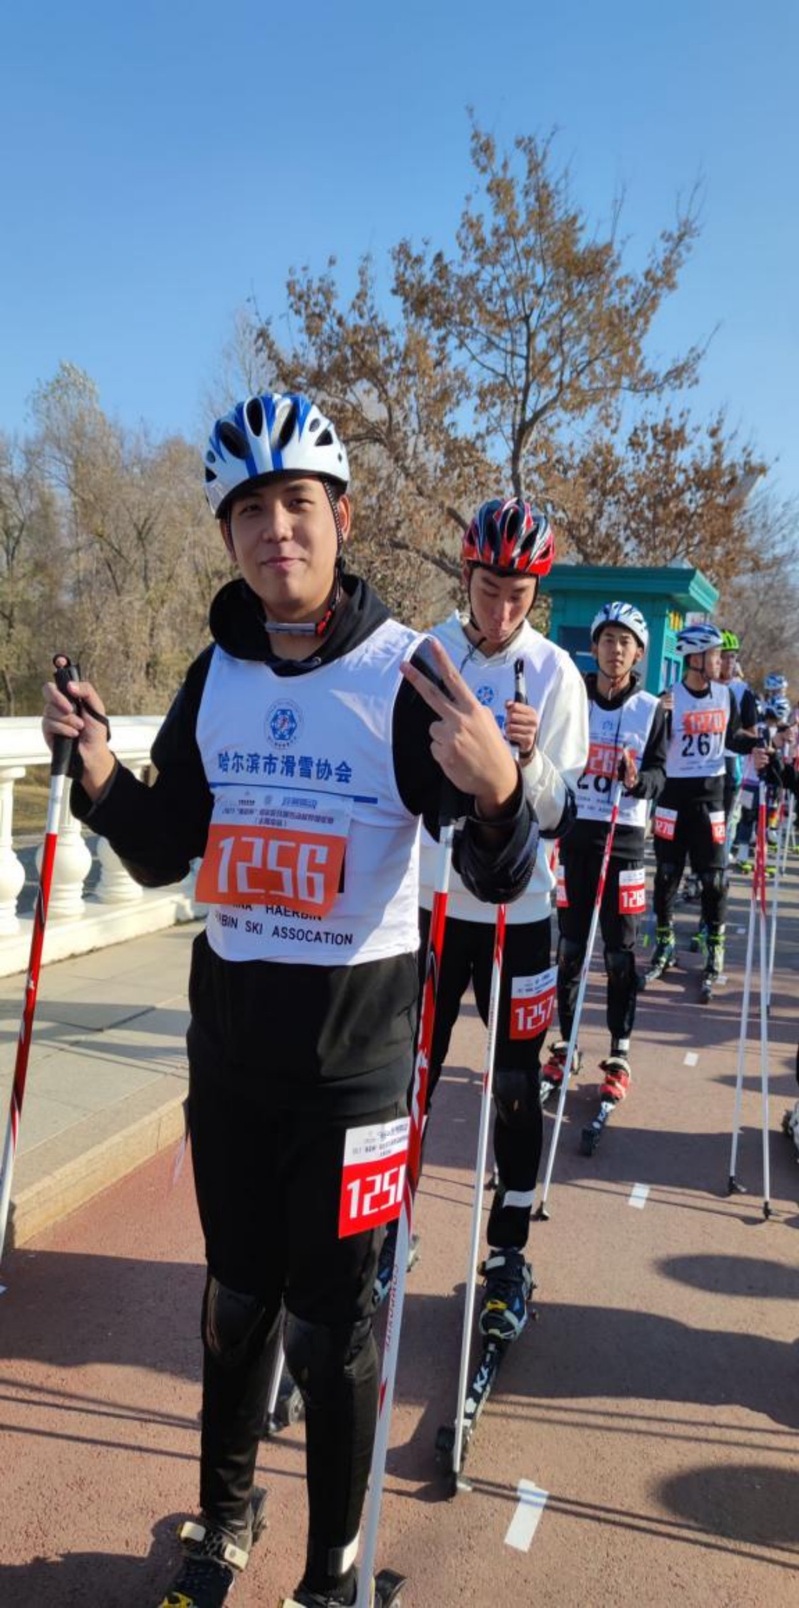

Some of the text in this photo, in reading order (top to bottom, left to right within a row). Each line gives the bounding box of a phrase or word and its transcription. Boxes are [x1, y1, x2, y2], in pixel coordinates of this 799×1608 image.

[218, 752, 352, 784] 哈尔滨市滑雪协会
[217, 836, 328, 905] 1256
[245, 920, 263, 935] SKI
[272, 925, 354, 946] ASSOCATION
[515, 995, 555, 1031] 1257
